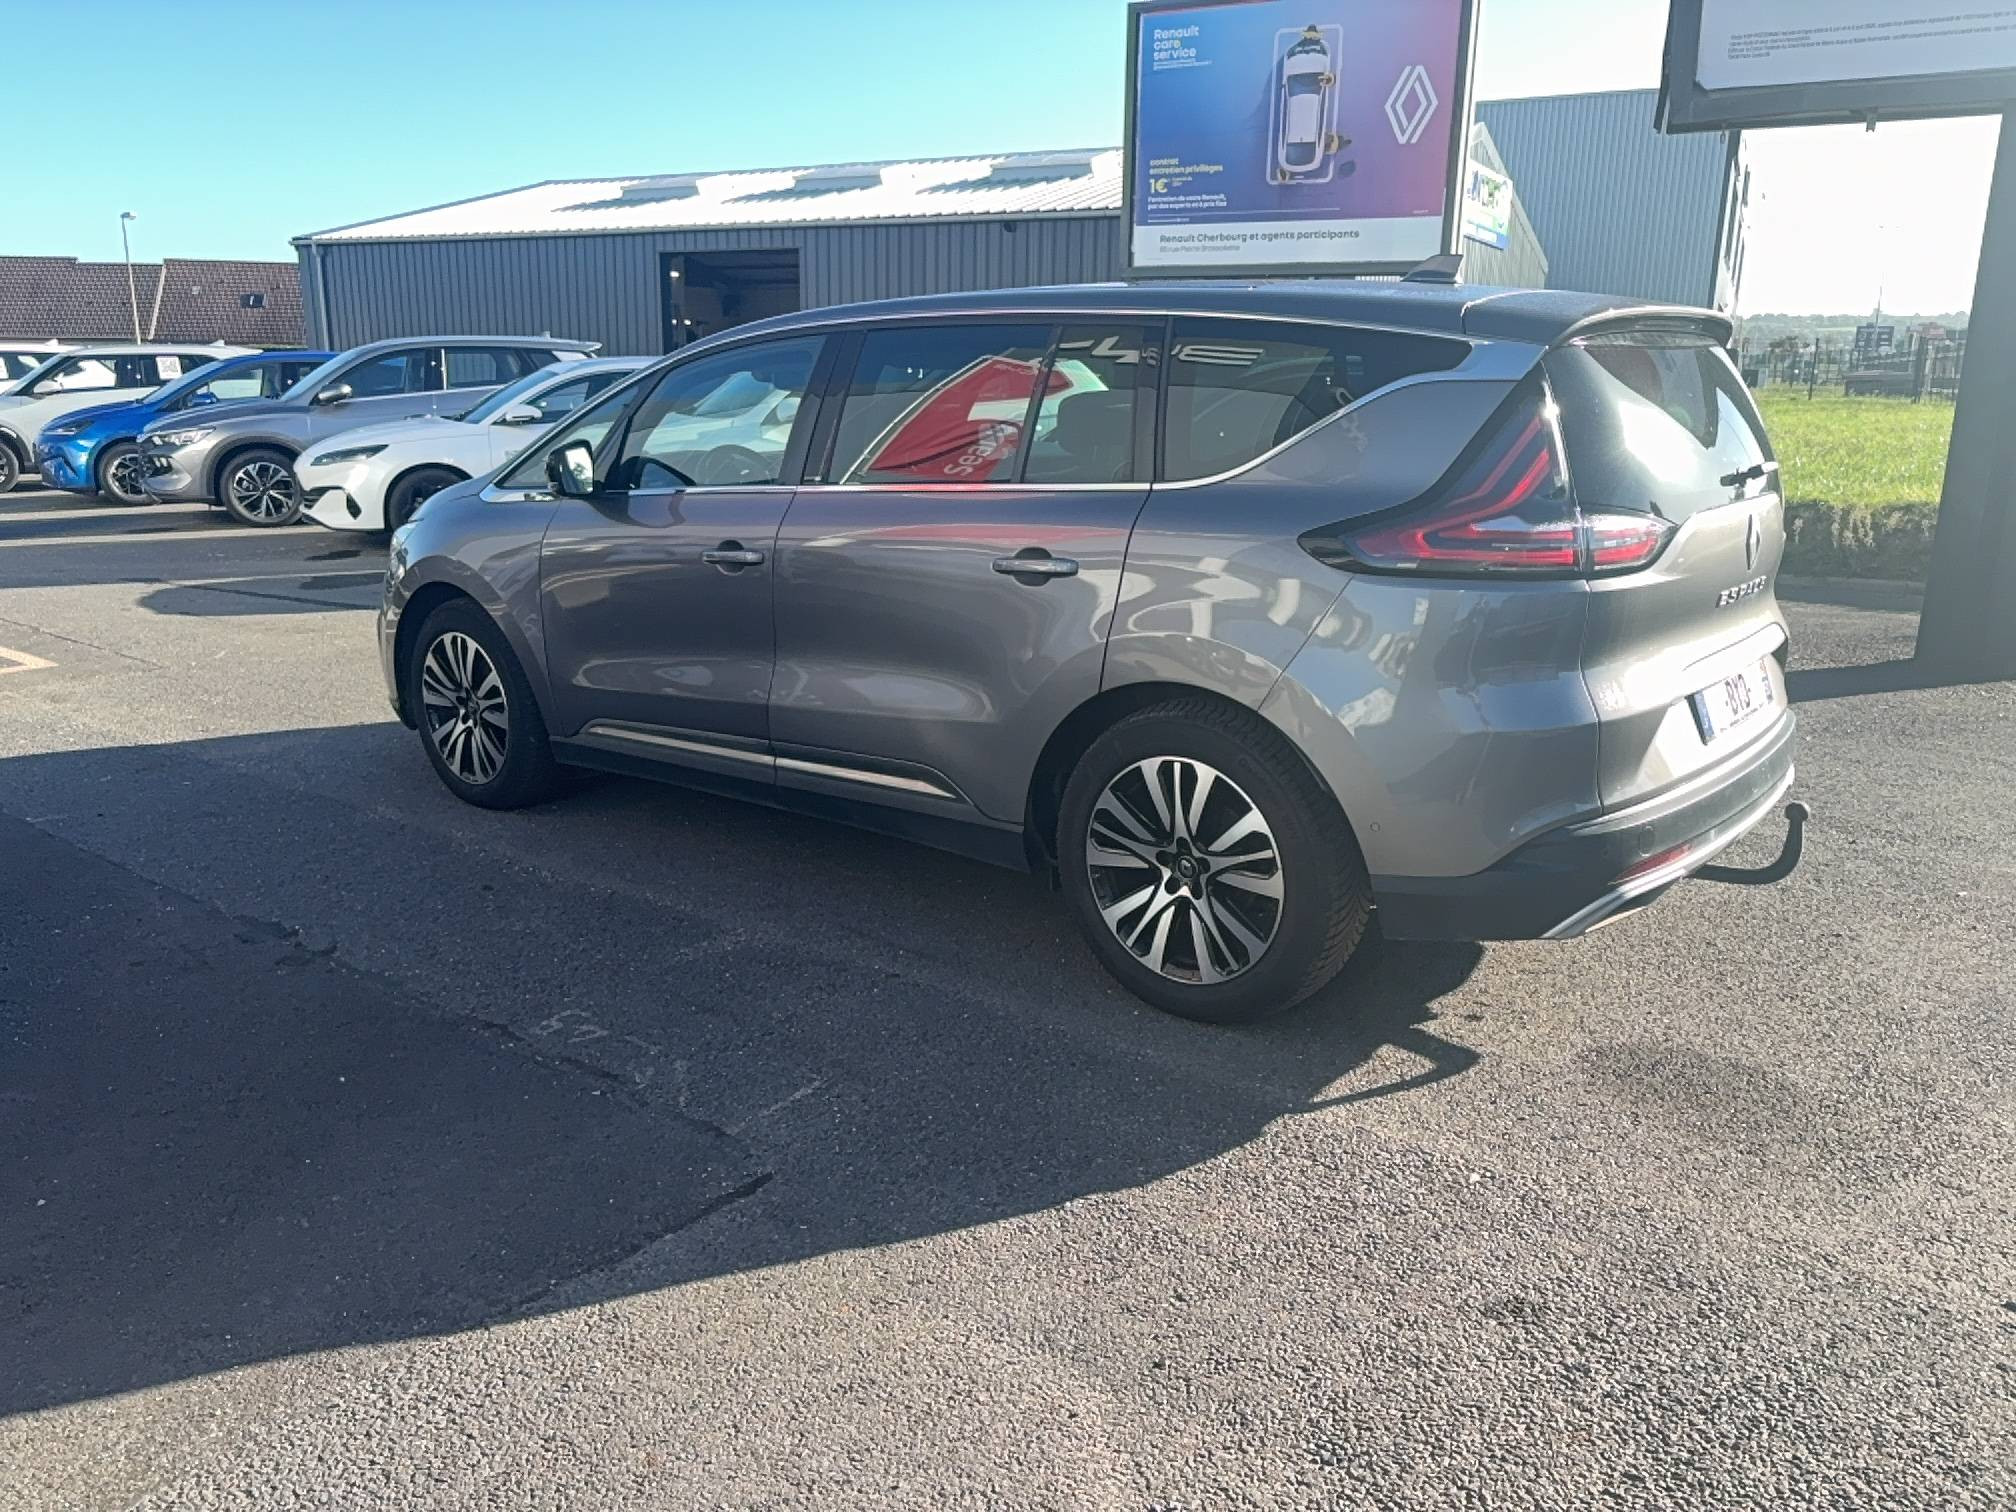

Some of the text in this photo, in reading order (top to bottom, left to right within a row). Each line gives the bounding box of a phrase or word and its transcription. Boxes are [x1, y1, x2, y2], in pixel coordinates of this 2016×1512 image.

[1154, 25, 1200, 40] Renault
[1154, 39, 1182, 50] care
[1154, 48, 1197, 60] service
[1160, 229, 1360, 243] Renault Cherbourg et agents participants
